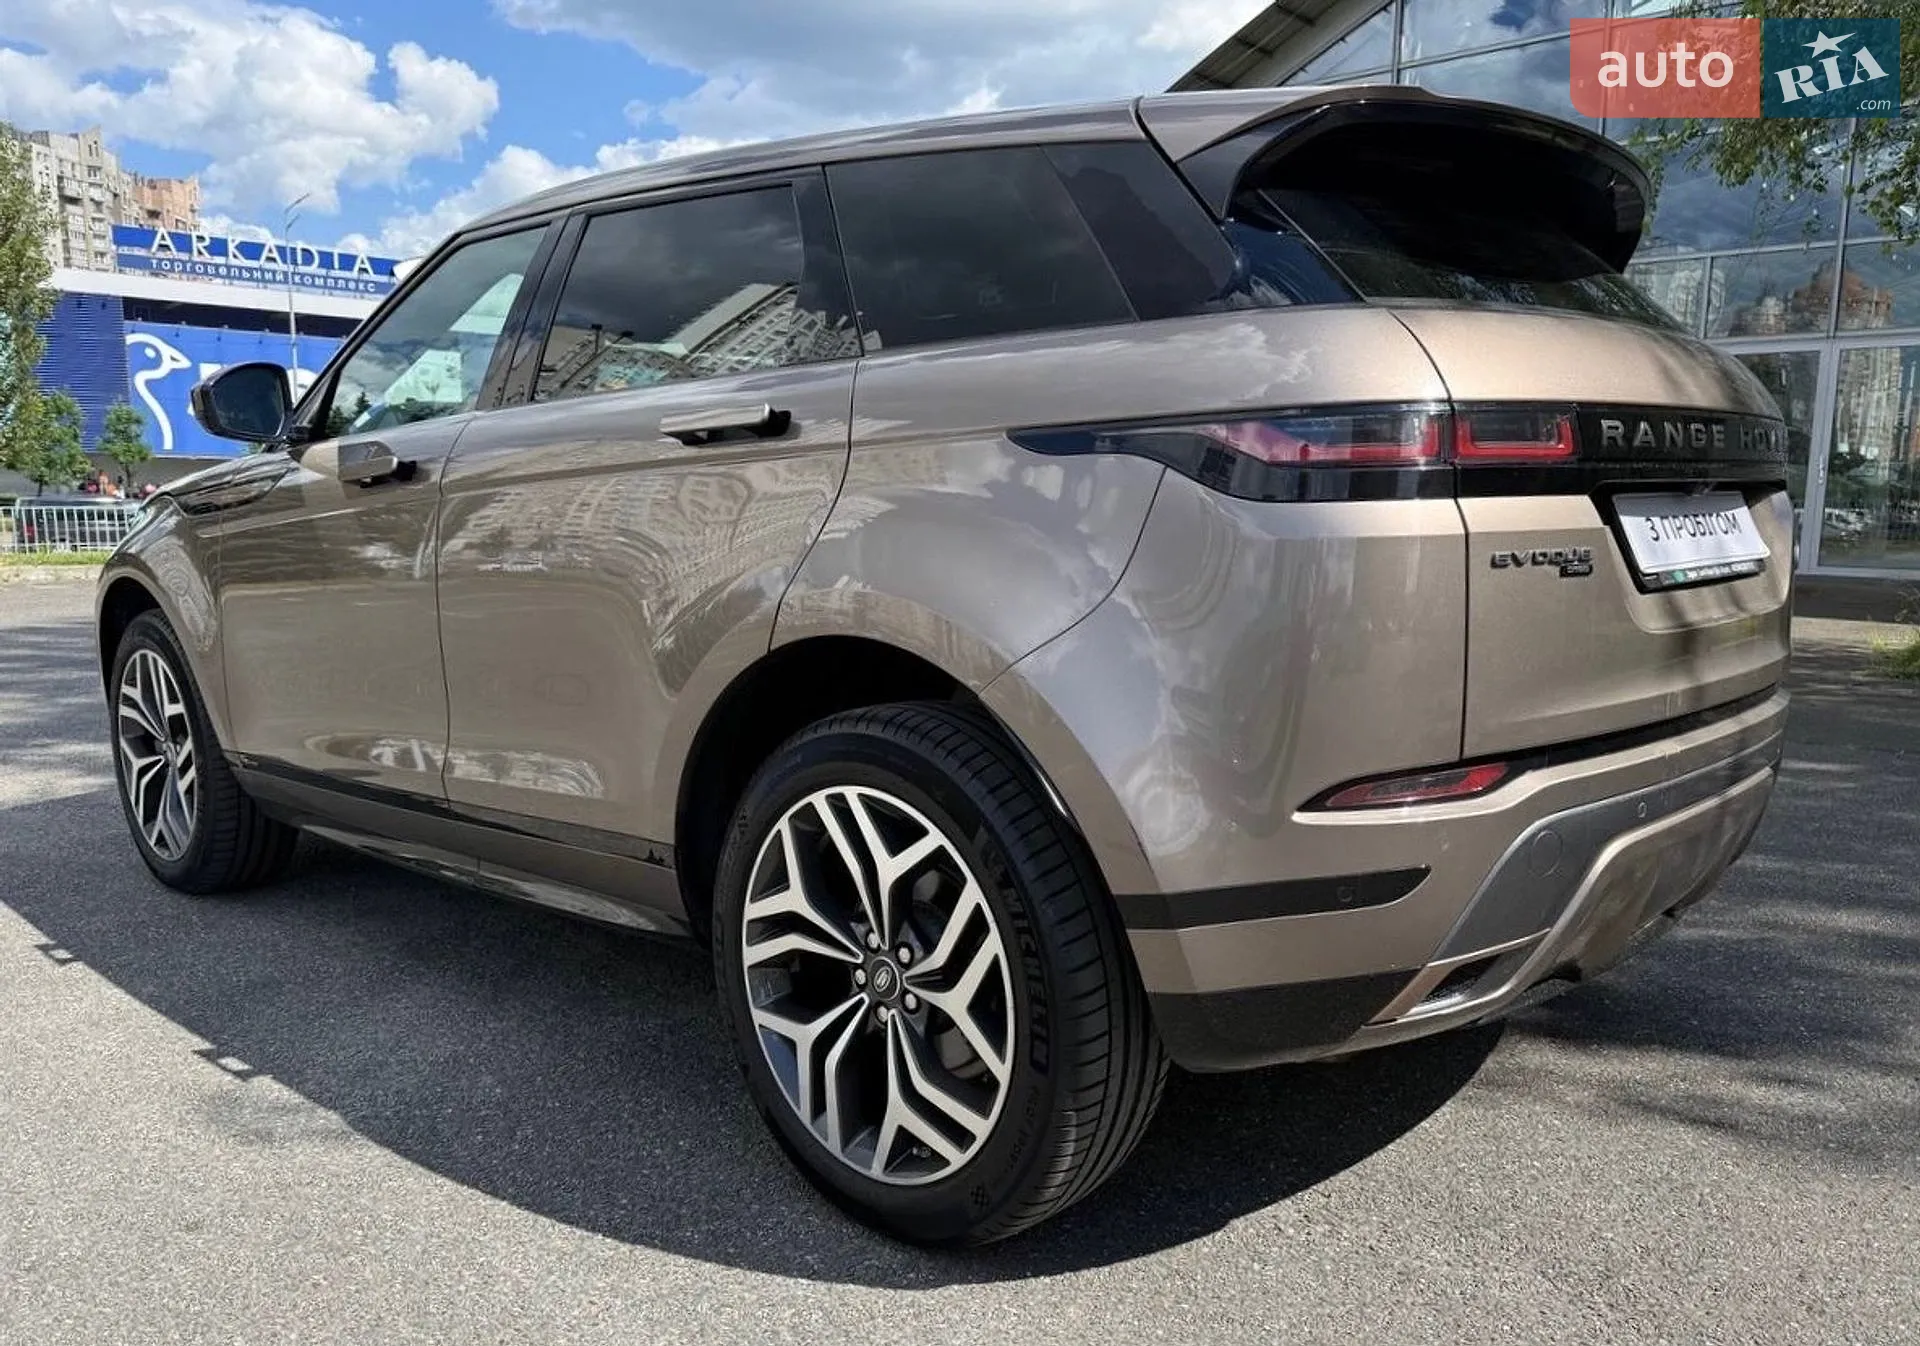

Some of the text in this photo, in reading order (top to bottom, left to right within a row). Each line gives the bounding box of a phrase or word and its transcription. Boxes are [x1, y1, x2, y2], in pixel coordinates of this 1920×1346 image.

[151, 227, 374, 277] ARKADIA
[151, 259, 376, 293] торговельний комплекс
[1600, 419, 1725, 449] RANGE
[1661, 511, 1743, 541] ПРОБІГОМ
[1490, 546, 1592, 569] EVOQUE
[1003, 885, 1048, 1068] MICHELIN
